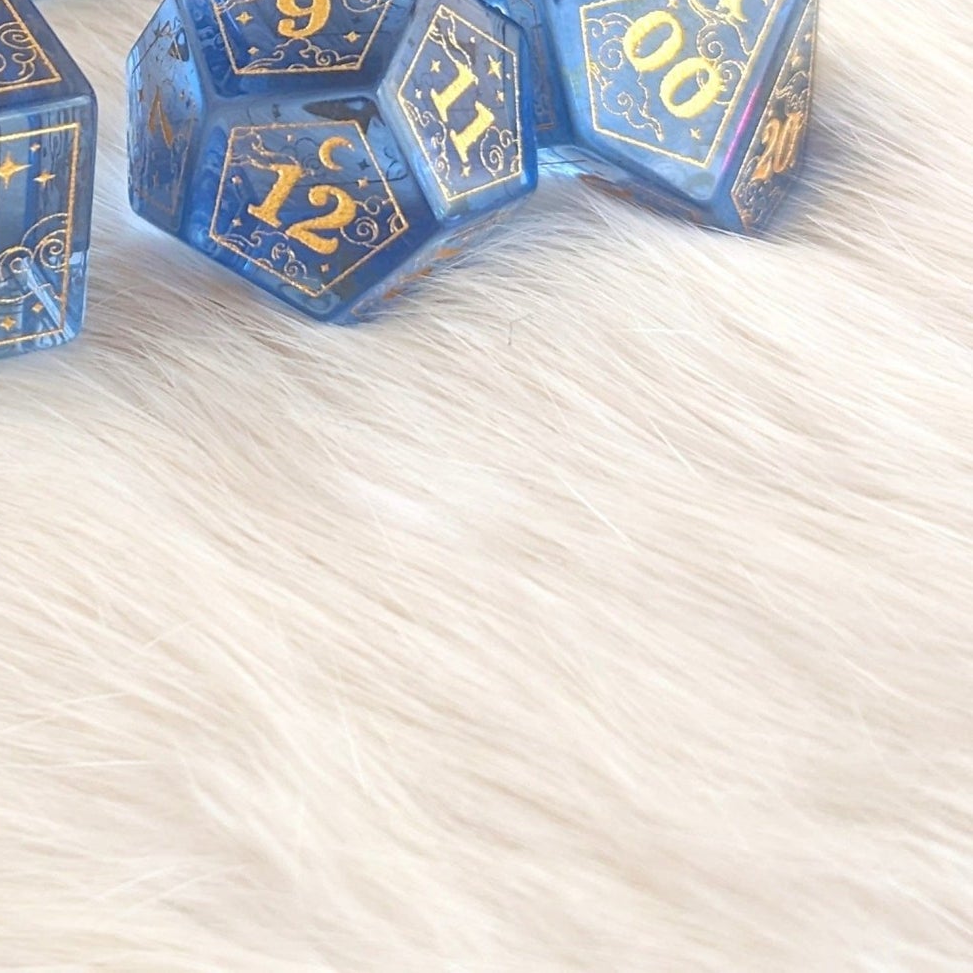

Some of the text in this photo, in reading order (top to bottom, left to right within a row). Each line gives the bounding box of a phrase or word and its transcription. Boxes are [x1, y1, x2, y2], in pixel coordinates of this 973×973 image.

[430, 61, 496, 164] 11
[623, 10, 724, 119] 00
[247, 164, 357, 255] 12
